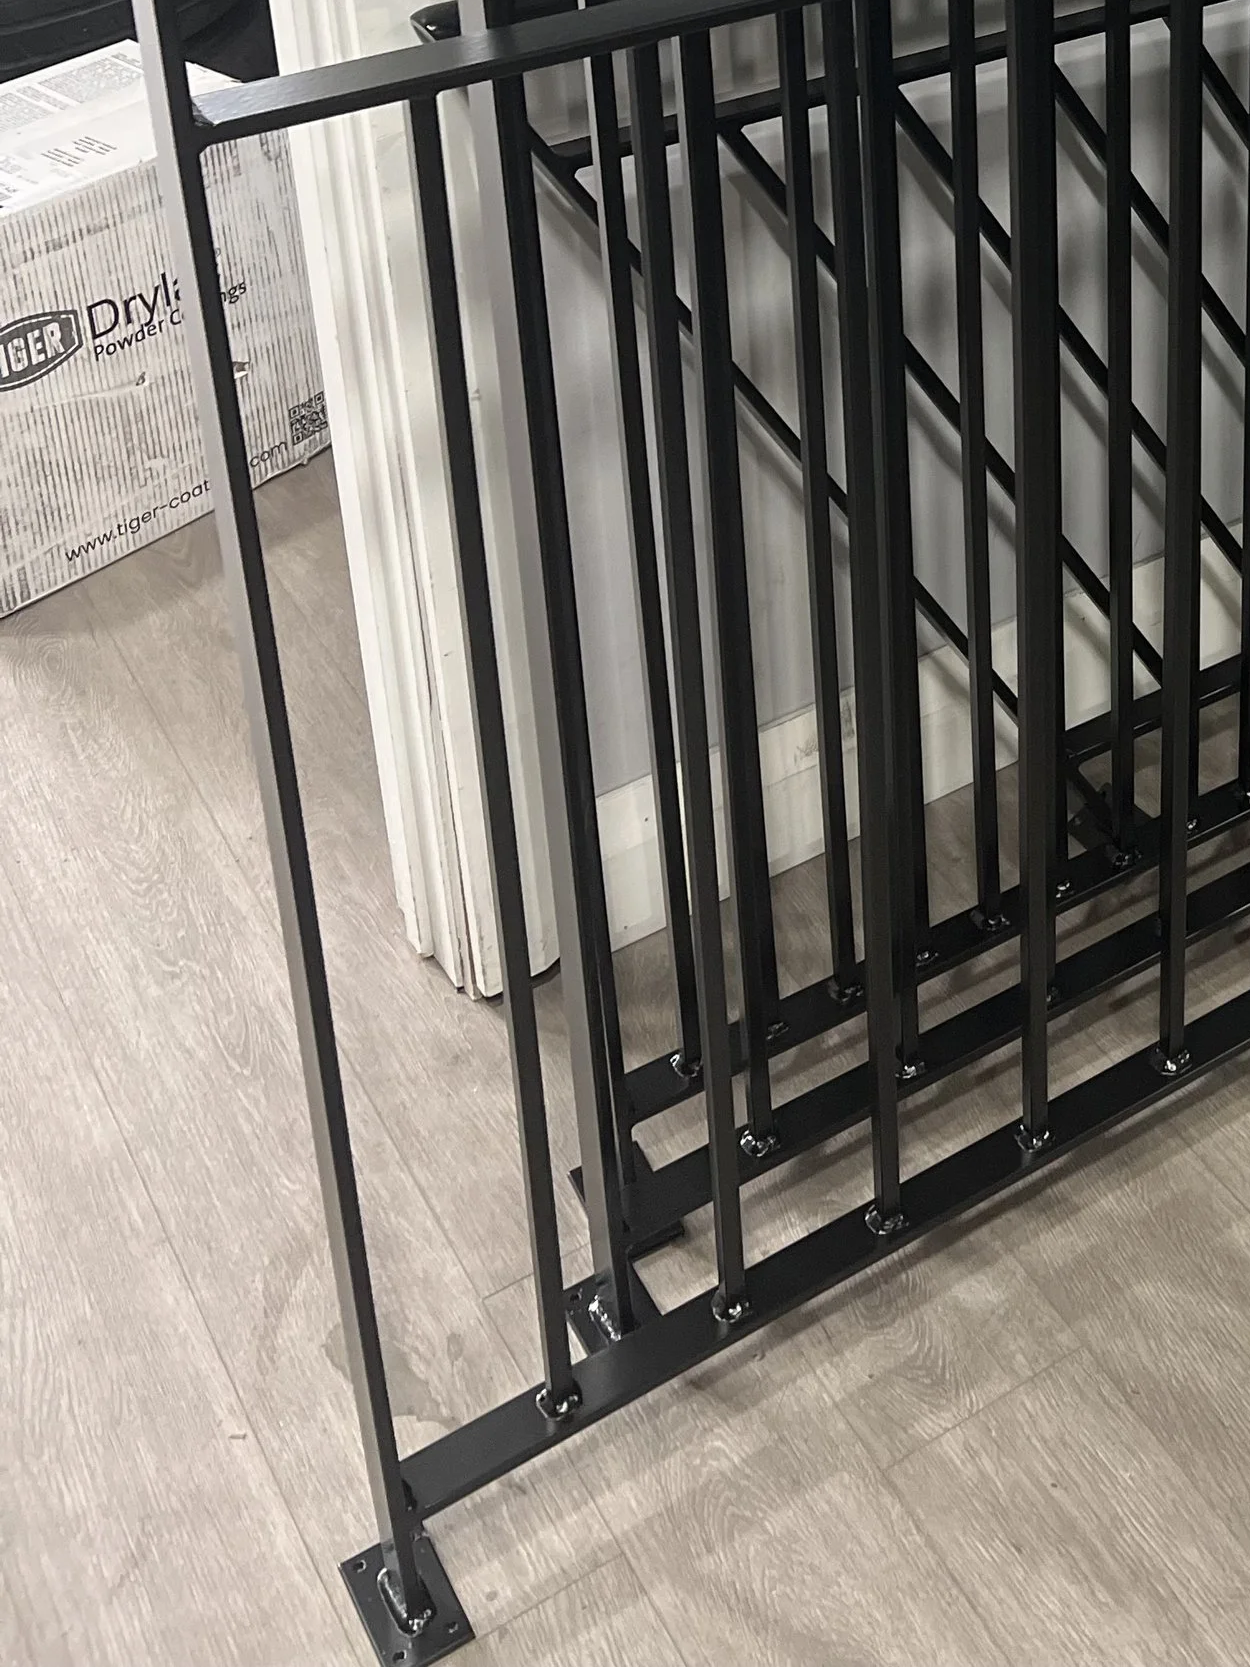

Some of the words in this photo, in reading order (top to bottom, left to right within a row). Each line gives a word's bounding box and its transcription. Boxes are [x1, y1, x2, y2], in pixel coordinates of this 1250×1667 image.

[86, 272, 181, 340] Dryl
[0, 321, 65, 379] IGER
[93, 317, 165, 362] Powder
